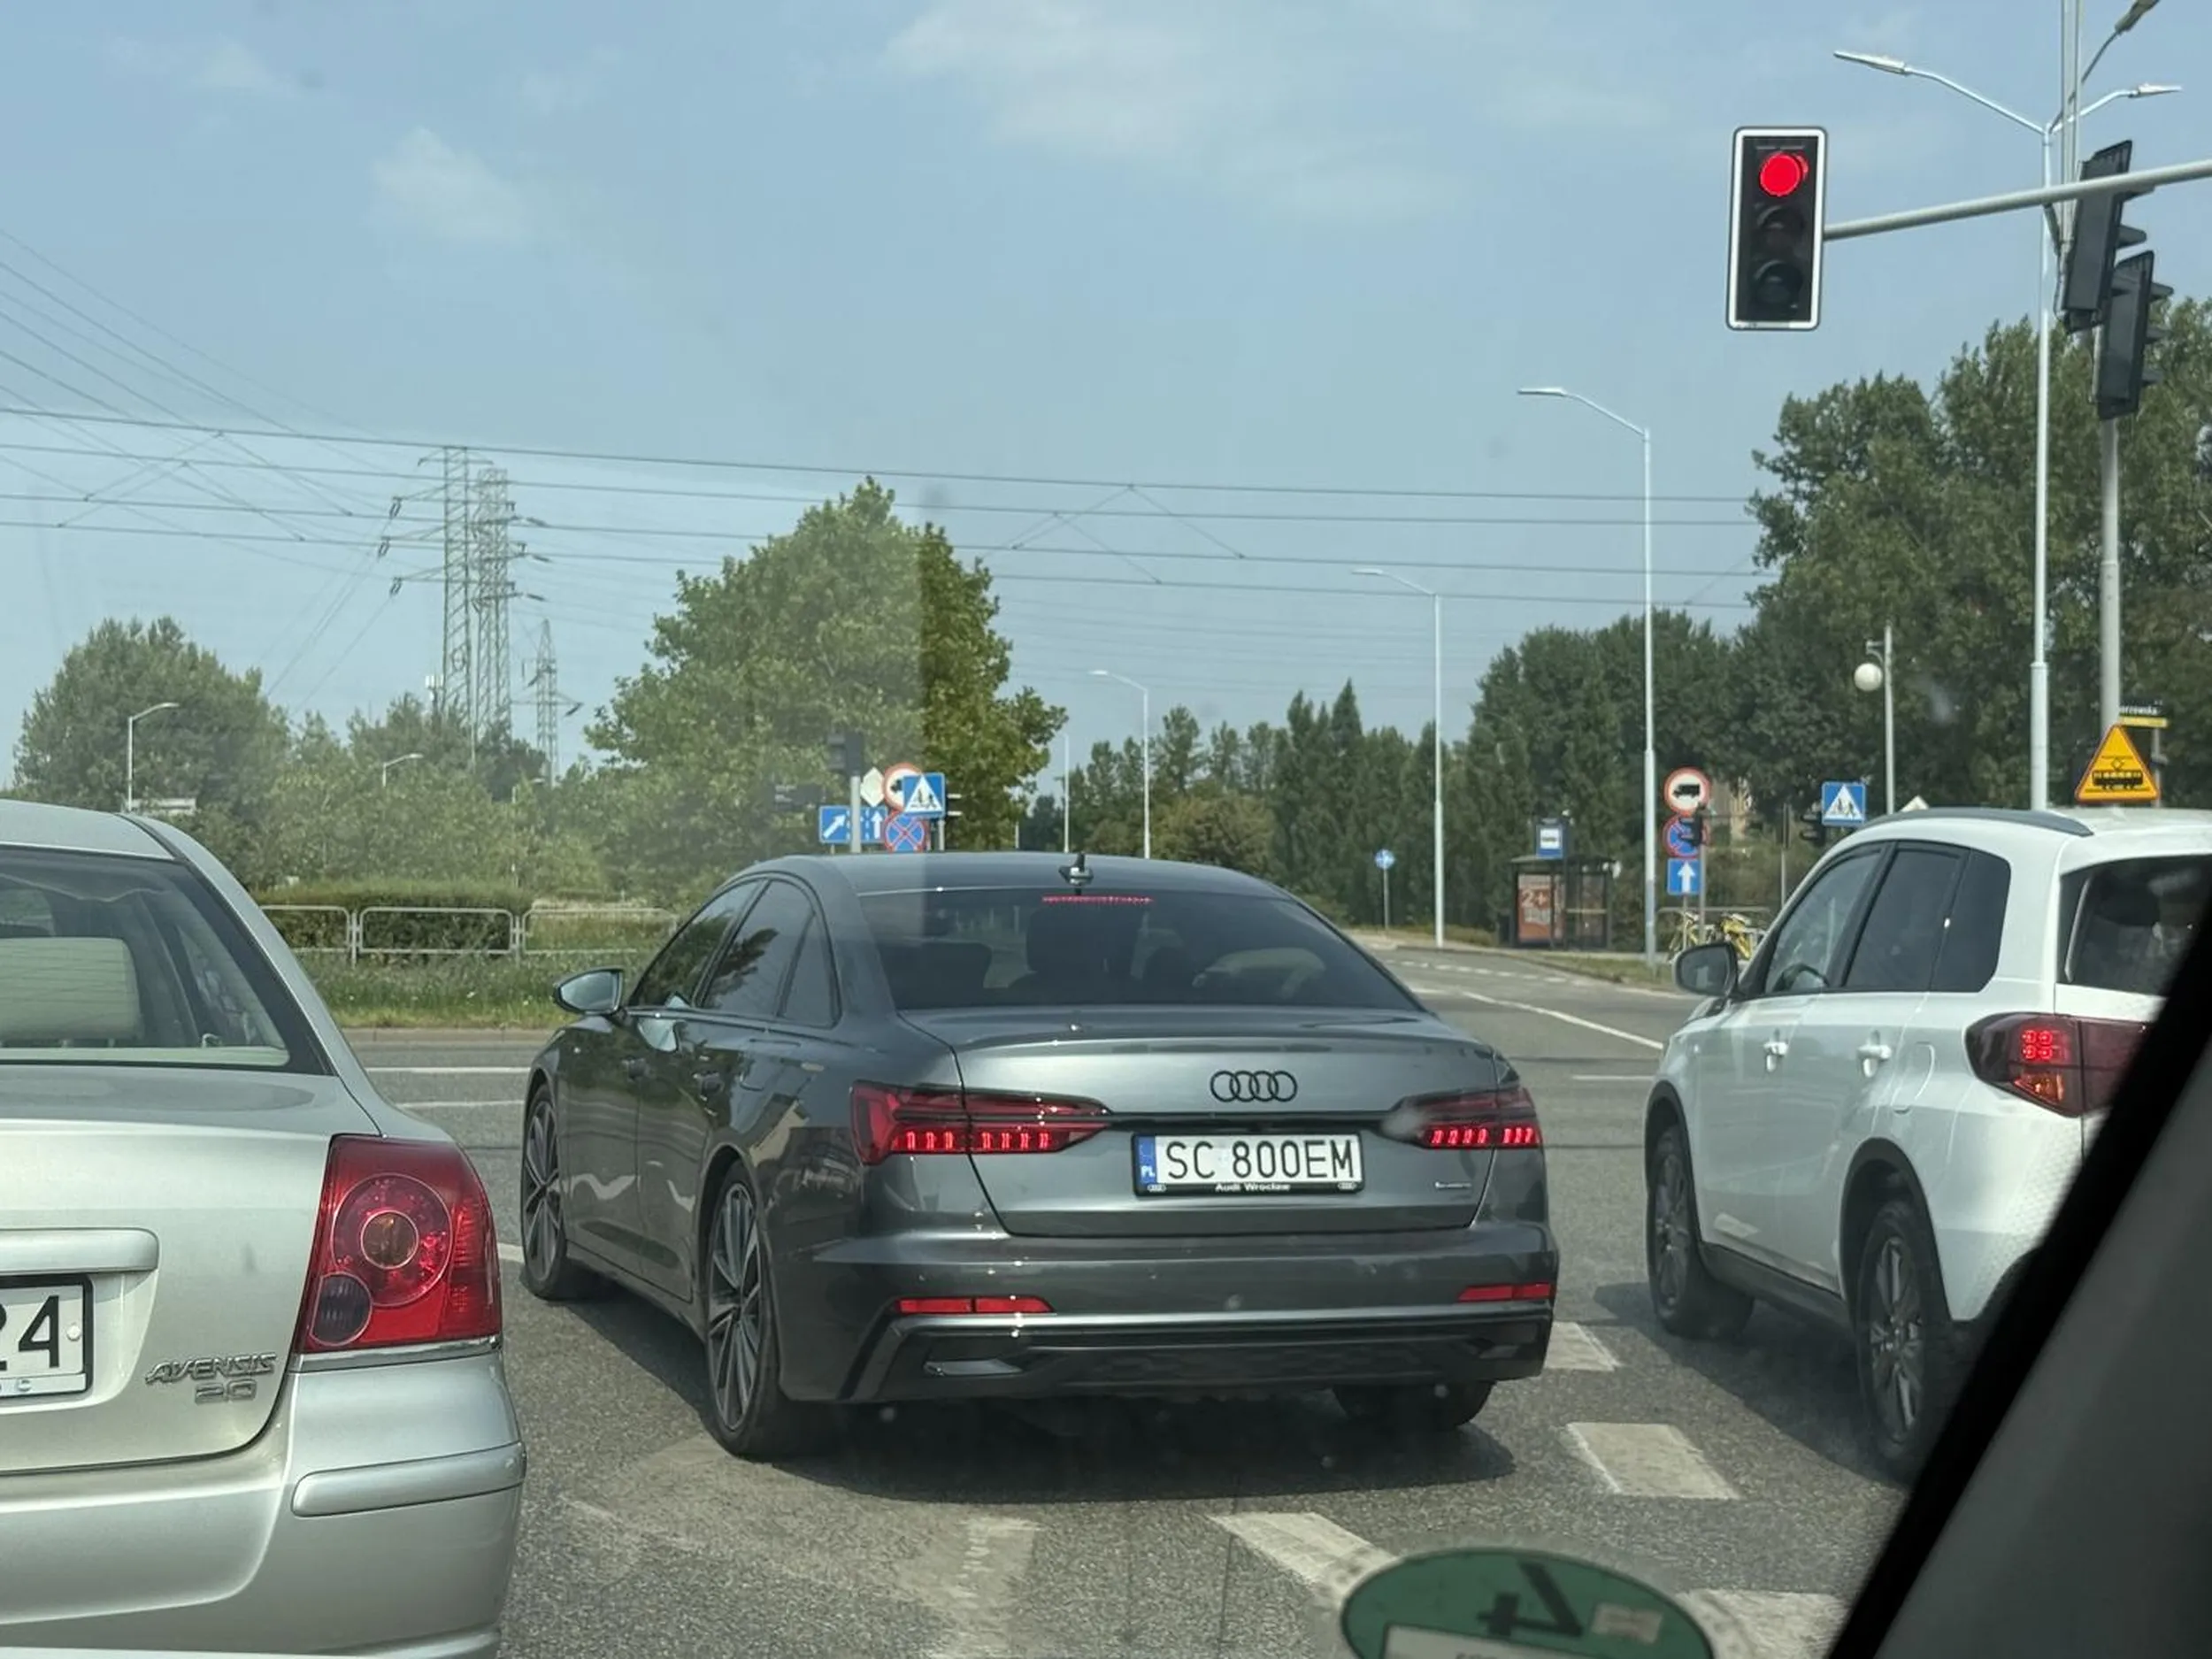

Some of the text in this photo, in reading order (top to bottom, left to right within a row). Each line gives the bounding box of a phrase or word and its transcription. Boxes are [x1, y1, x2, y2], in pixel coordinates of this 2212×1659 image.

[1166, 1140, 1354, 1179] SC 800EM
[1215, 1183, 1240, 1192] Audi
[0, 1295, 59, 1371] 4
[144, 1352, 277, 1384] AVENSIS
